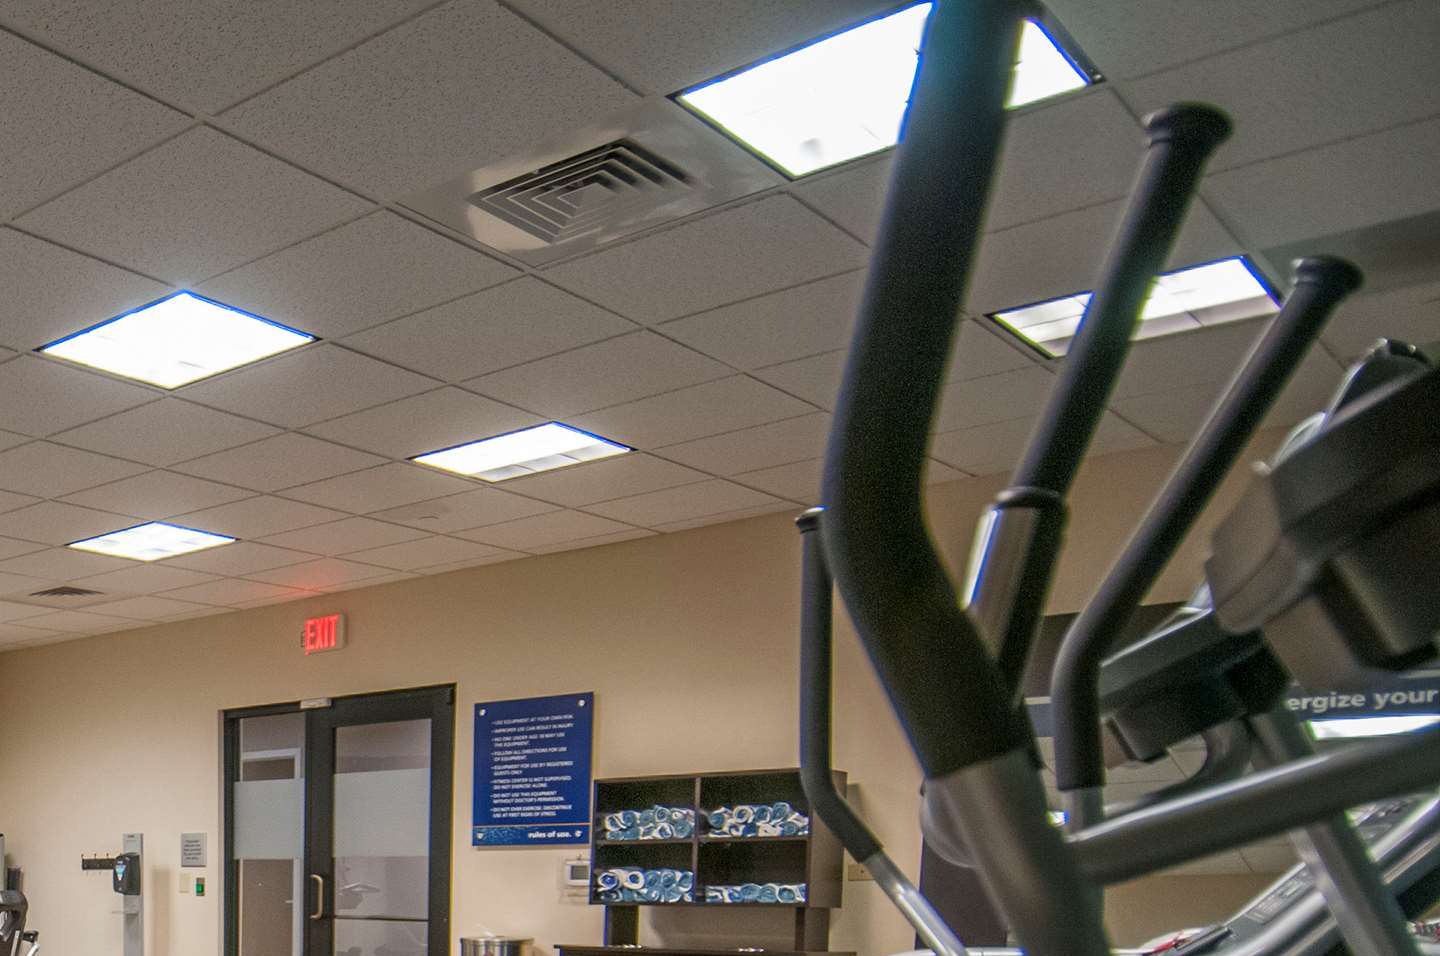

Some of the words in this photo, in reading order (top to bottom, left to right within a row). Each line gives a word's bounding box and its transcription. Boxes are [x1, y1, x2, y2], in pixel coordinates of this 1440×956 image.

[305, 615, 339, 650] EXIT
[1287, 692, 1366, 713] ergize
[1374, 690, 1438, 709] your
[547, 830, 556, 838] of
